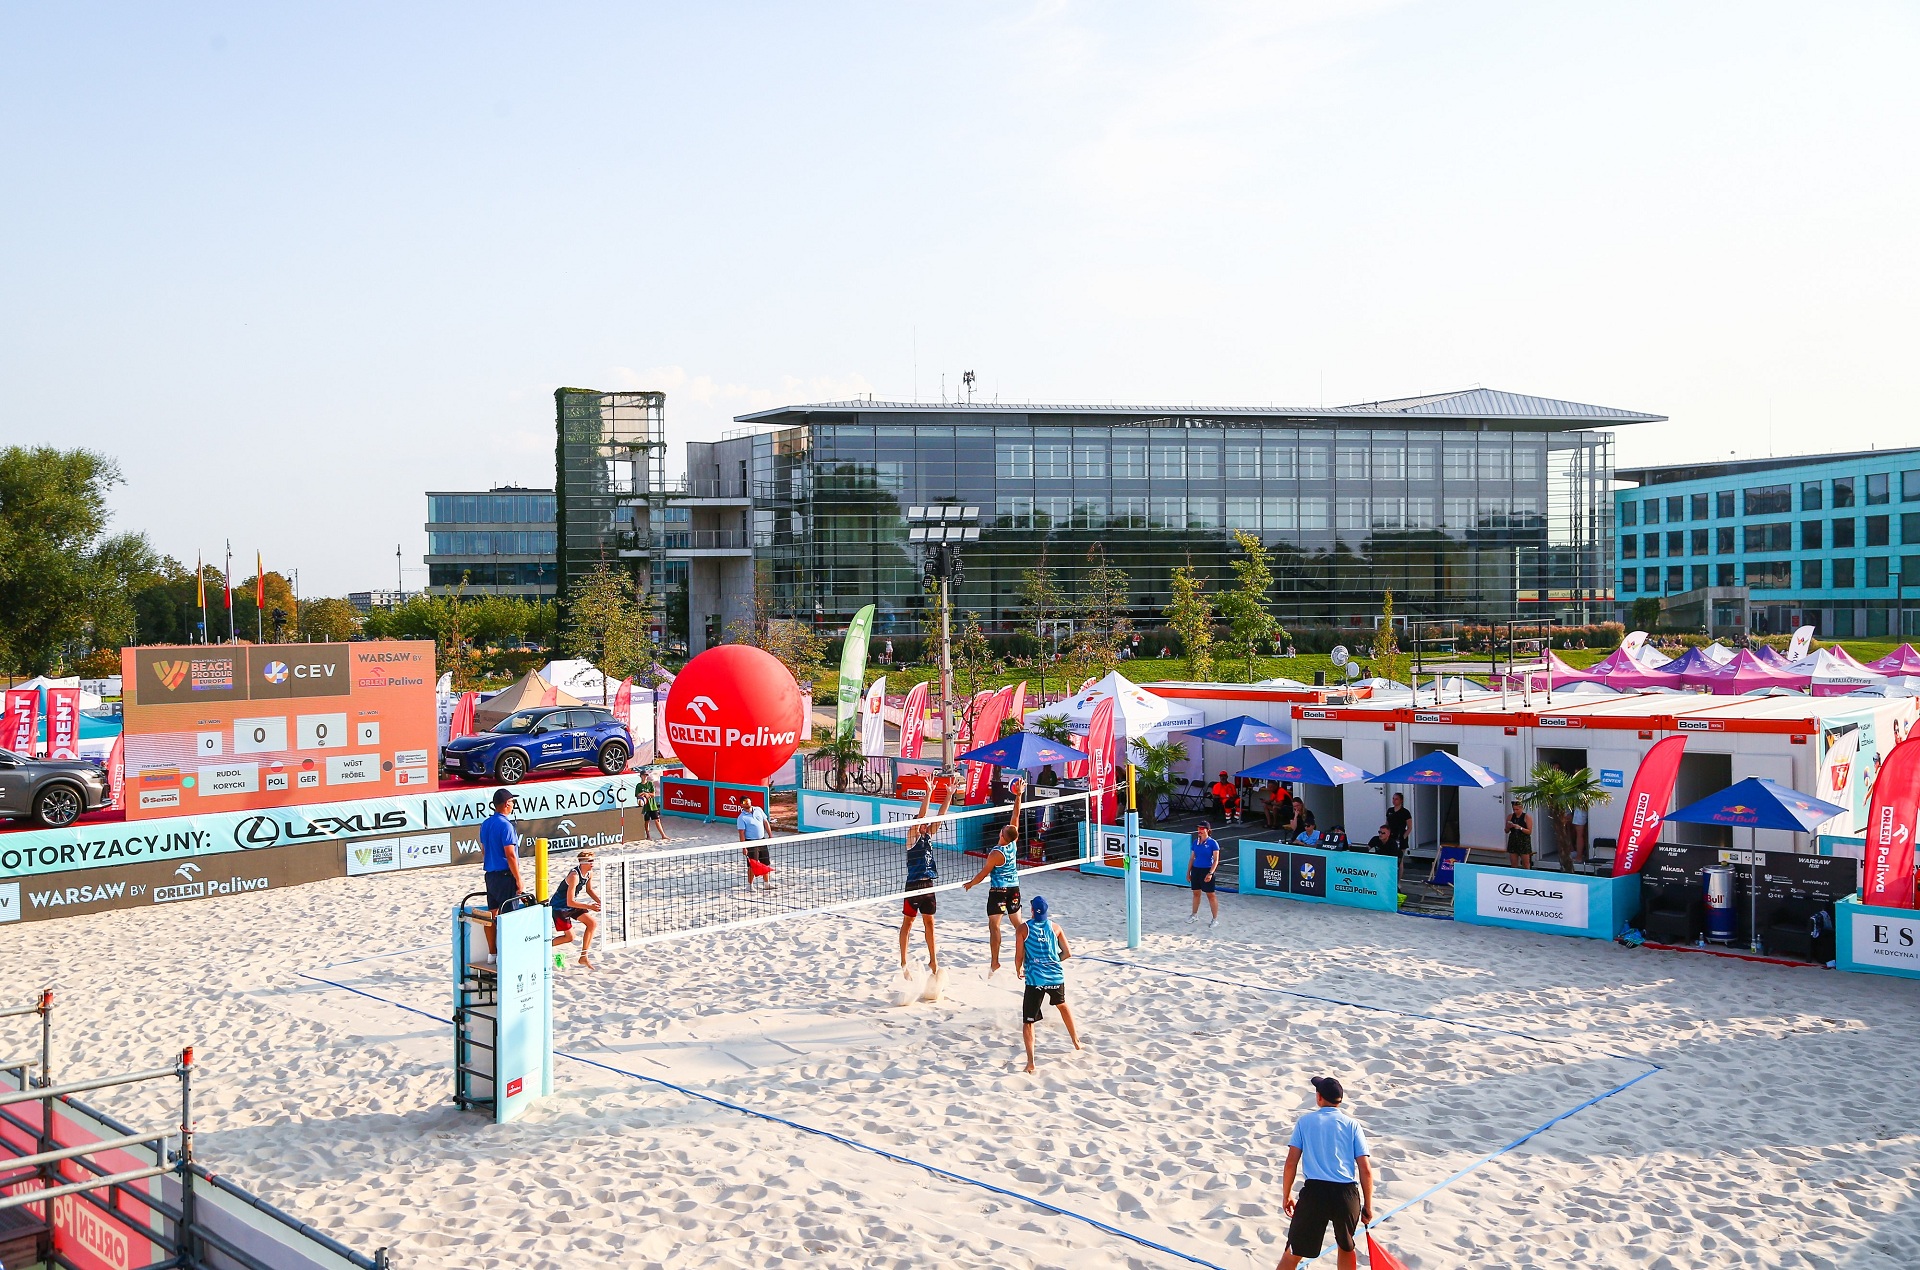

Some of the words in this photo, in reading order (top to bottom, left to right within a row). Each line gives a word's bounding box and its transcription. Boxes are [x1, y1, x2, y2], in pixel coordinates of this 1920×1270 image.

[358, 652, 411, 662] WARSAW
[192, 662, 232, 672] BEACH
[294, 664, 336, 678] CEV
[80, 681, 106, 696] rit
[360, 678, 385, 686] ORLEN
[388, 677, 422, 686] Paliwa
[254, 728, 266, 743] 0
[316, 724, 328, 738] 0
[365, 729, 372, 738] 0
[672, 726, 716, 743] ORLEN
[726, 726, 795, 746] Paliwa
[206, 740, 213, 748] 0
[970, 766, 980, 798] Paliwa
[111, 793, 119, 810] Pali
[444, 796, 550, 822] WARSAWA
[821, 808, 855, 819] enel-sport
[1634, 794, 1648, 826] ORLEN
[1713, 814, 1734, 822] Red
[1880, 808, 1891, 842] ORLEN
[2, 830, 211, 869] OTORYZACYJNY:
[284, 810, 407, 839] LEXUS
[580, 832, 623, 847] Paliwa
[422, 845, 443, 854] CEV
[1107, 837, 1159, 857] Bls
[1624, 828, 1640, 869] Paliwa
[1335, 866, 1369, 876] WARSAW
[1876, 847, 1889, 893] Paliwa
[29, 881, 126, 909] WARSAW
[130, 884, 146, 896] BY
[156, 884, 201, 900] ORLEN
[207, 876, 268, 895] Paliwa
[1354, 886, 1377, 895] Paliwa
[1516, 888, 1563, 899] LEXUS
[1498, 906, 1534, 915] WARSZAWA
[1874, 949, 1914, 958] MEDYCYNA
